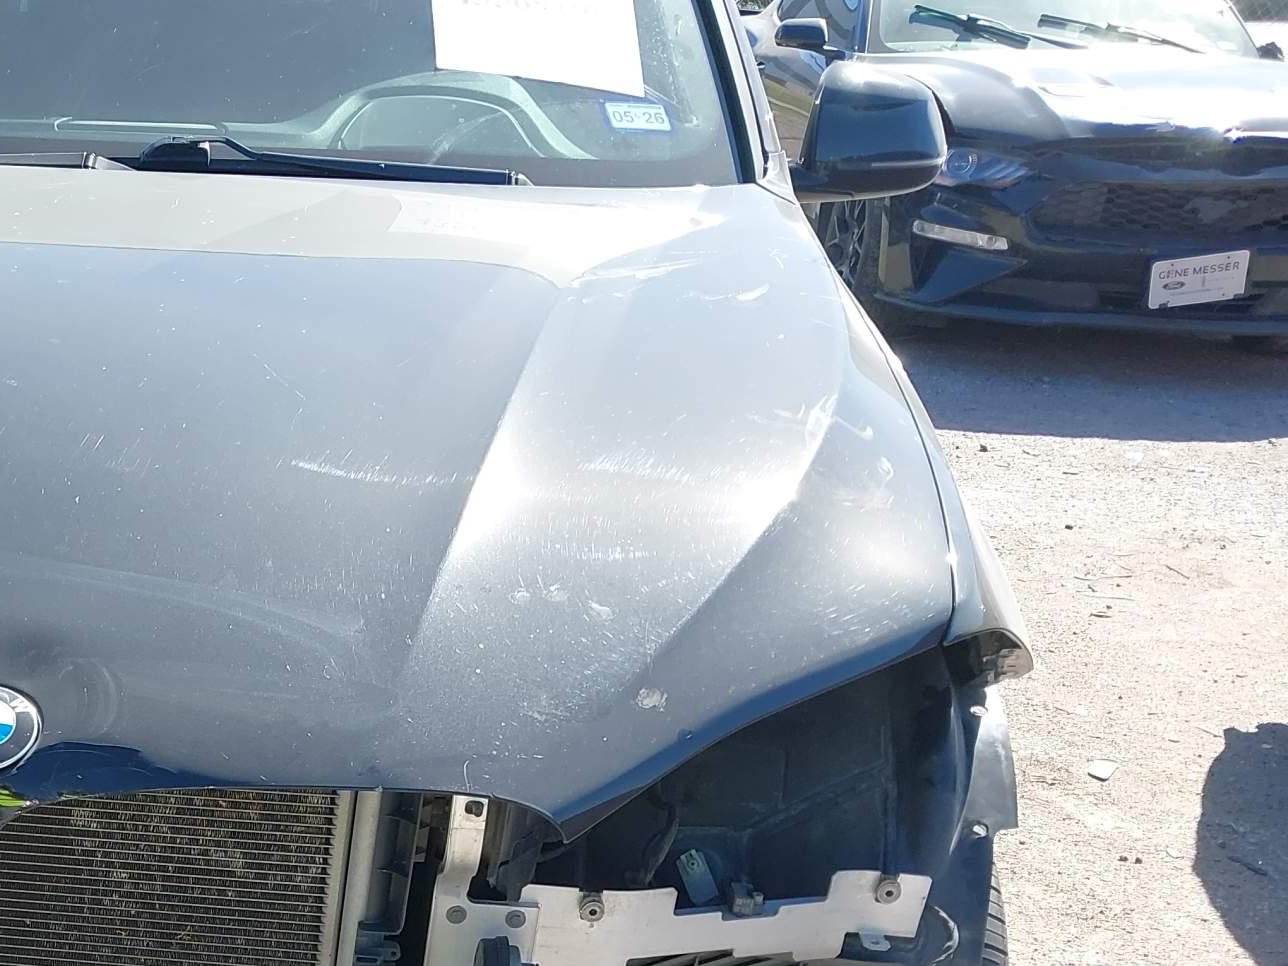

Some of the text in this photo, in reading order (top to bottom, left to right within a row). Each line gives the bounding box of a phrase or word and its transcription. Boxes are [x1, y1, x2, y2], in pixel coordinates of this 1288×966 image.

[642, 111, 665, 125] 26
[1158, 261, 1240, 280] GENE MESSER
